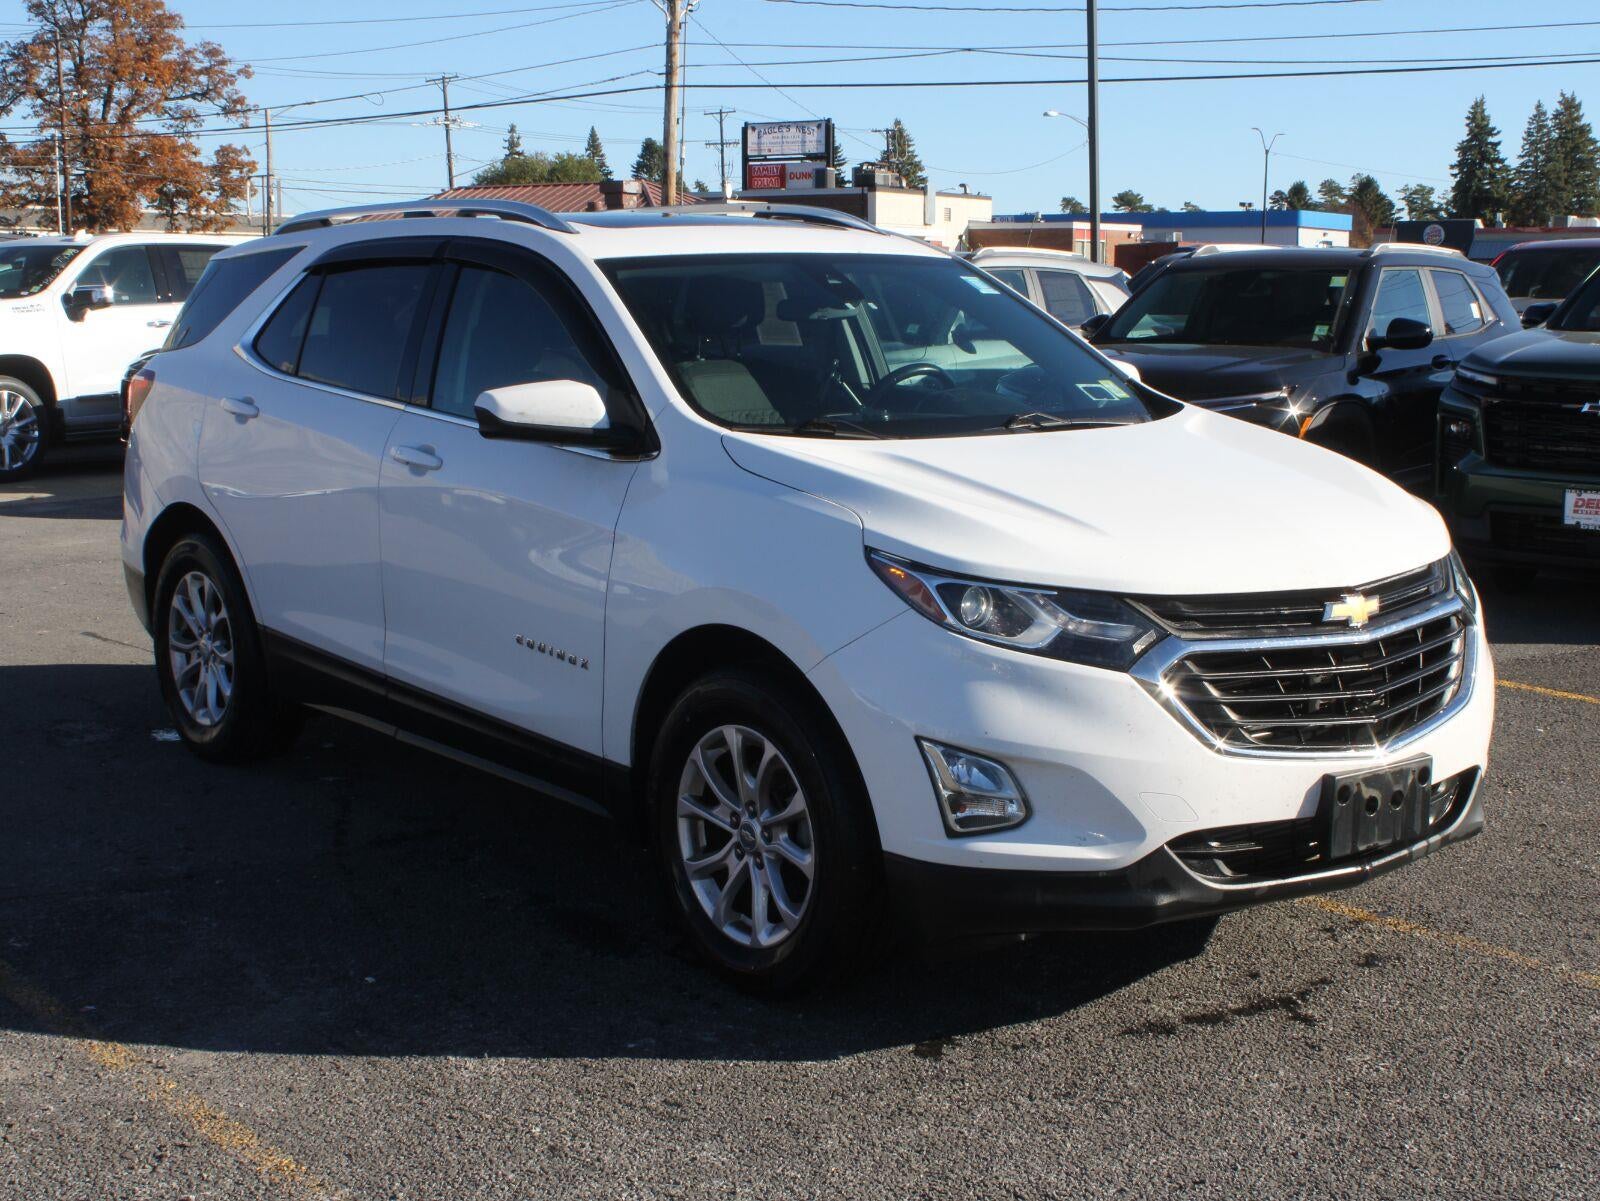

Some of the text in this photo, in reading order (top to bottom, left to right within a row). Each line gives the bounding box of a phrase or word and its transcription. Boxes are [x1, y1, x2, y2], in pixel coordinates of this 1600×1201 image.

[757, 124, 791, 139] EAGLE'S
[795, 125, 815, 137] NEST
[751, 165, 781, 177] FAMILY
[515, 633, 590, 671] EQUINOX
